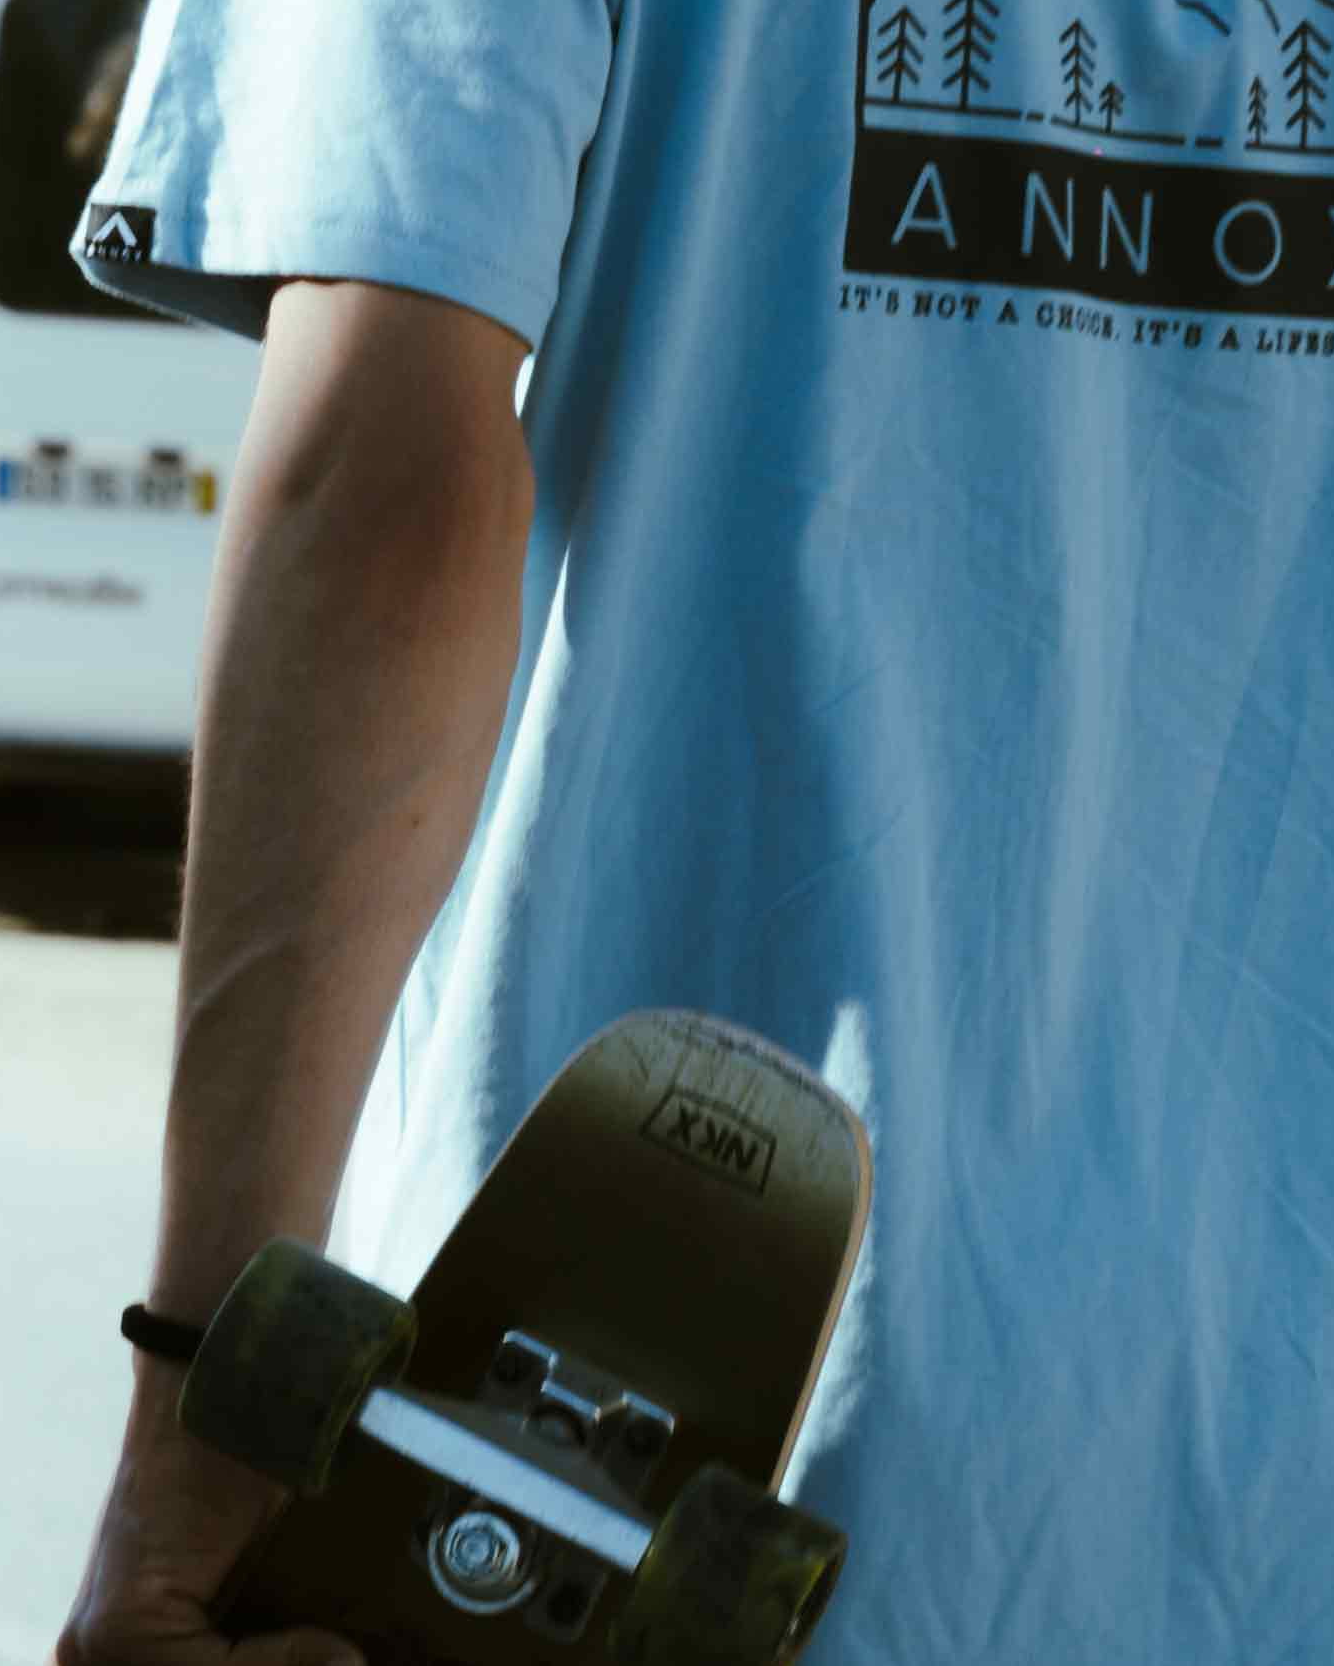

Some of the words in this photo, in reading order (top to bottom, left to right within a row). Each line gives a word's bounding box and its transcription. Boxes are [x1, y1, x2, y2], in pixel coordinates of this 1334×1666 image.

[839, 284, 900, 316] IT'S
[913, 291, 982, 323] NOT
[997, 299, 1020, 327] A
[1133, 317, 1204, 349] IT'S
[1220, 326, 1240, 351] A
